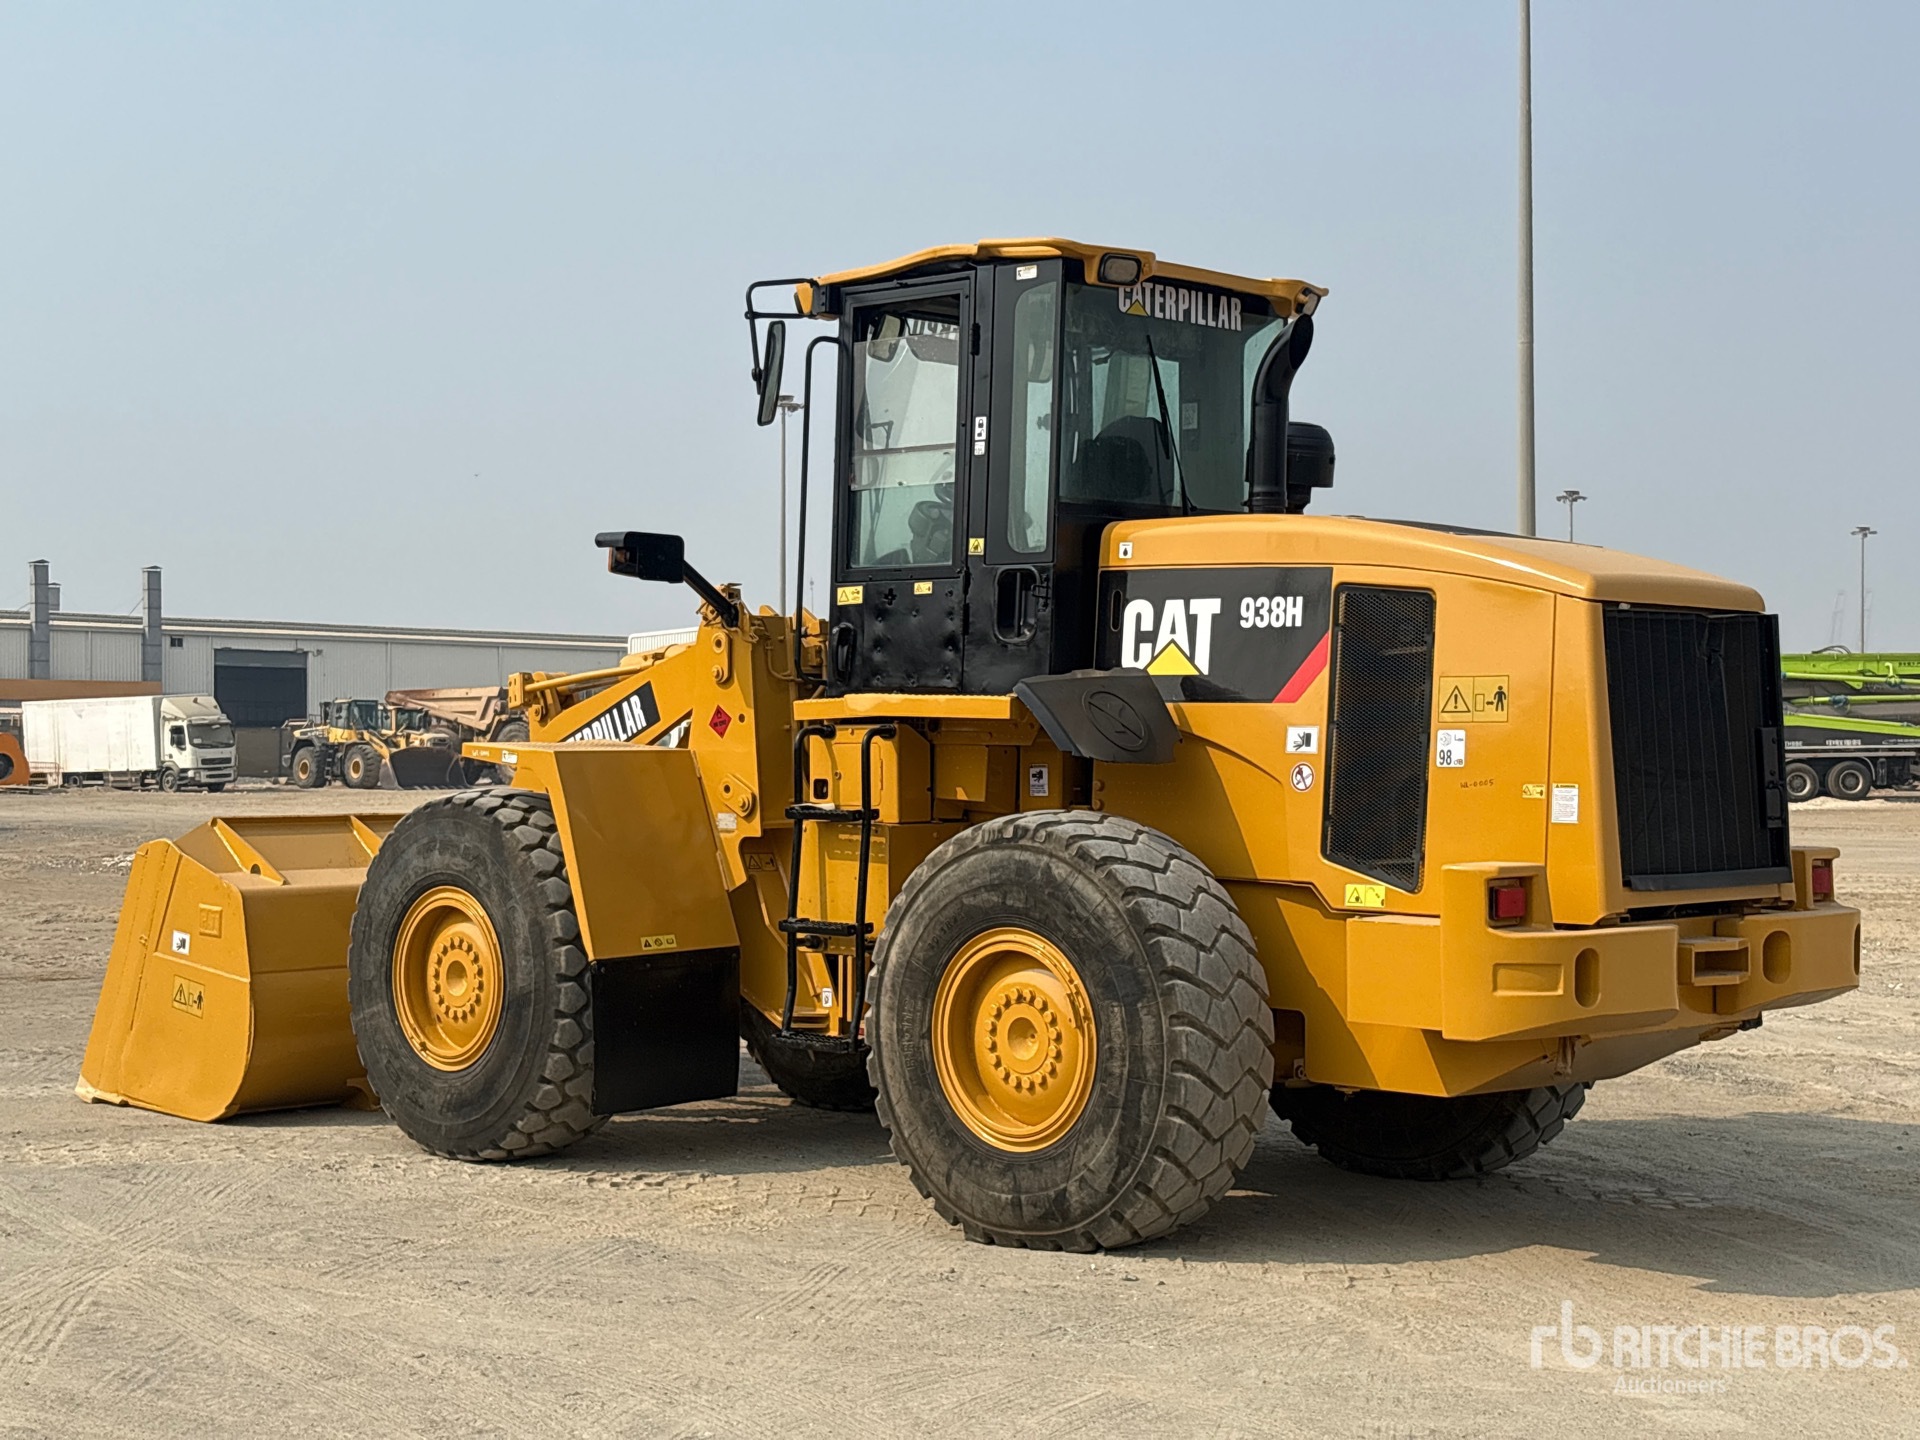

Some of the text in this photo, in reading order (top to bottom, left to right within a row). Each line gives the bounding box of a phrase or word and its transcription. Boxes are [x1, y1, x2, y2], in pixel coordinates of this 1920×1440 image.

[1118, 281, 1242, 332] CATERPILLAR
[1239, 596, 1304, 629] 938H
[1121, 598, 1222, 676] CAT
[1438, 749, 1452, 766] 98
